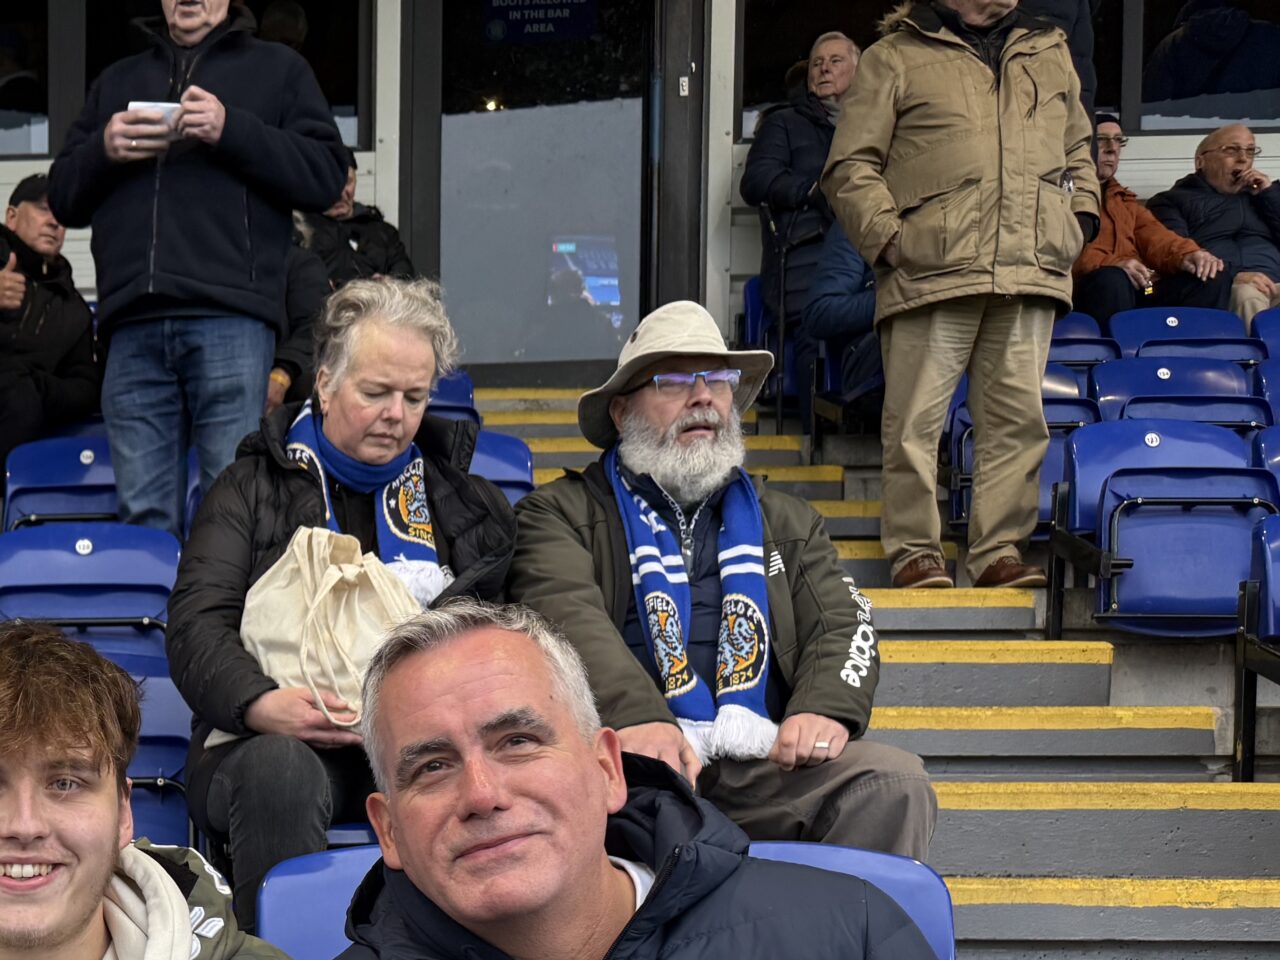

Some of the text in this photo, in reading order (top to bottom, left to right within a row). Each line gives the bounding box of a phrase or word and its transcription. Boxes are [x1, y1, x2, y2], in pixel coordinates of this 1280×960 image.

[509, 8, 570, 20] IN THE BAR
[524, 22, 555, 33] AREA
[666, 670, 688, 691] 1874
[730, 667, 753, 687] 1874
